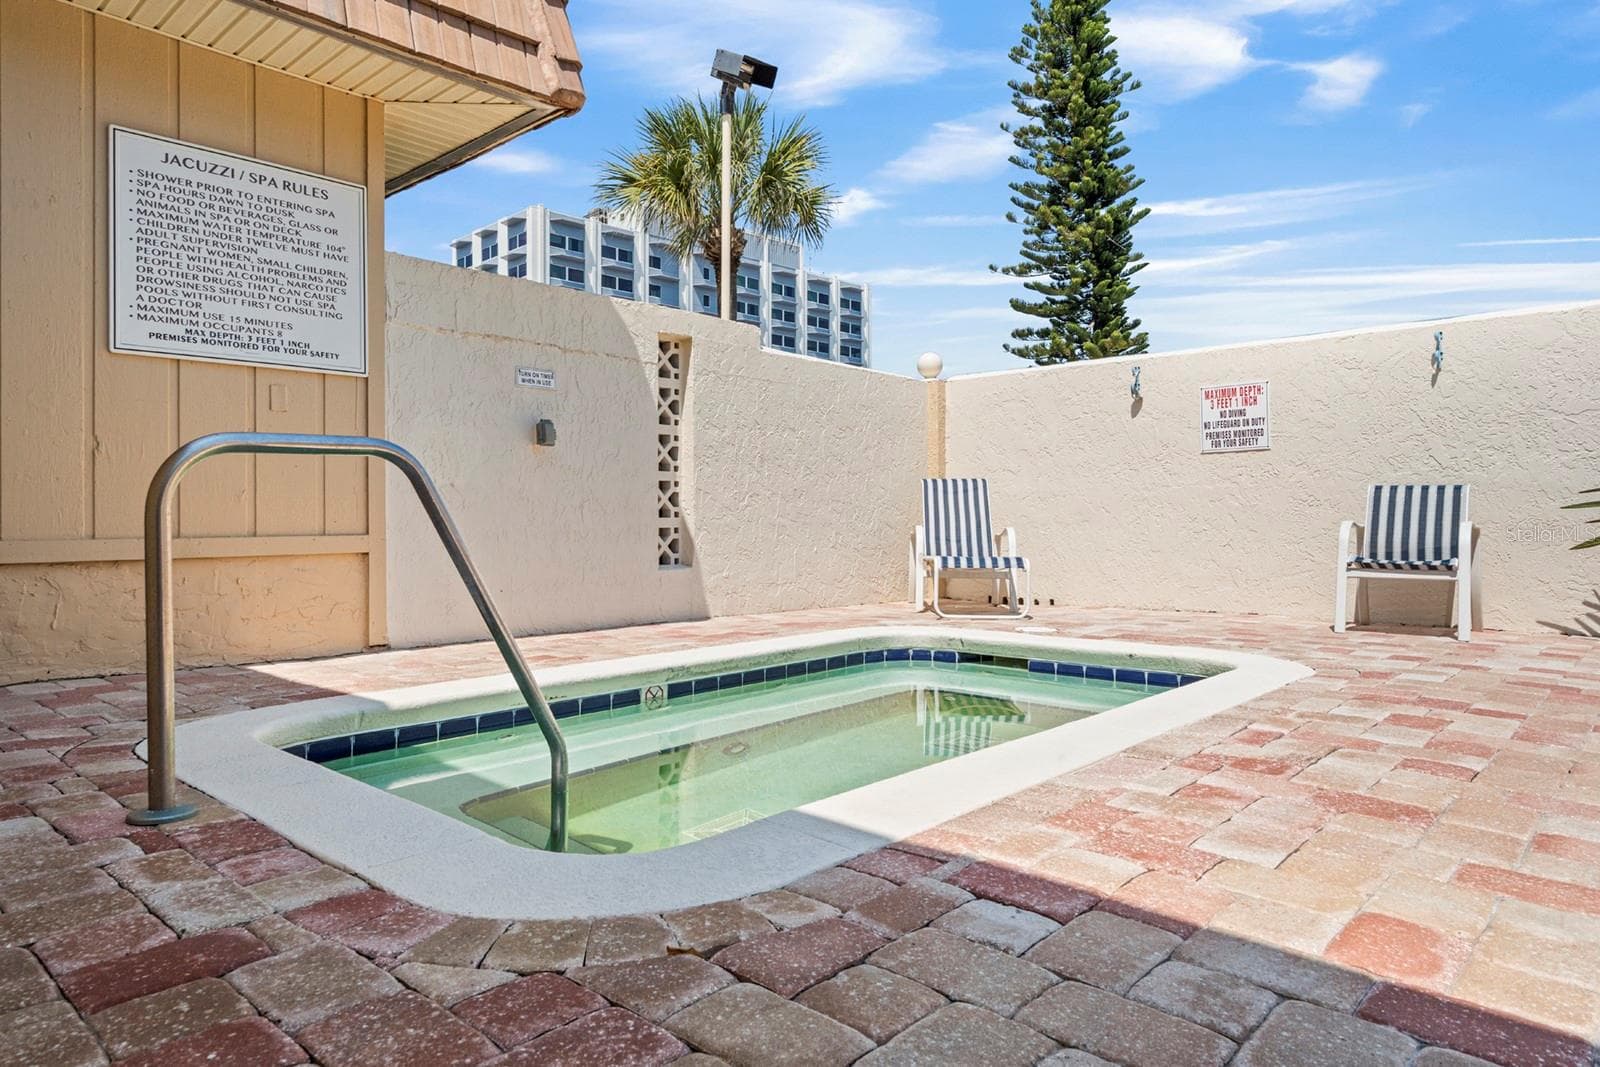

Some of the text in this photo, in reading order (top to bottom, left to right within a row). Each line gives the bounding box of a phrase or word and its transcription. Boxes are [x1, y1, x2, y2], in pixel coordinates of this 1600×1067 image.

[161, 153, 328, 200] JACUZZI / SPA RULES
[137, 169, 335, 218] SHOWER PRIOR TO ENTERING SPA
[137, 179, 295, 218] SPA HOURS DAWN TO DUSK
[136, 198, 191, 215] ANIMALS
[210, 213, 231, 223] SPA
[234, 218, 250, 227] OR
[253, 221, 269, 230] ON
[273, 225, 302, 237] DECK
[137, 189, 155, 198] NO
[160, 193, 195, 206] FOOD
[199, 202, 215, 210] OR
[289, 220, 321, 232] GLASS
[324, 227, 338, 236] OR
[137, 208, 199, 226] MAXIMUM
[202, 220, 242, 234] WATER
[247, 229, 321, 249] TEMPERATURE
[136, 228, 258, 254] ADULT SUPERVISION
[137, 218, 349, 263] CHILDREN UNDER TWELVE MUST HAVE
[137, 237, 202, 254] PREGNANT
[257, 257, 292, 270] SMALL
[136, 246, 183, 260] PEOPLE
[186, 254, 217, 266] WITH
[221, 260, 264, 274] HEALTH
[268, 269, 323, 284] PROBLEMS
[136, 256, 183, 269] PEOPLE
[187, 264, 223, 275] USING
[287, 280, 346, 295] NARCOTICS
[136, 265, 336, 302] OR OTHER DRUGS THAT CAN CAUSE
[136, 275, 336, 310] DROWSINESS SHOULD NOT USE SPA
[136, 285, 343, 320] POOLS WITHOUT FIRST CONSULTING
[137, 304, 199, 318] MAXIMUM
[203, 312, 225, 321] USE
[244, 318, 293, 330] MINUTES
[148, 295, 202, 309] DOCTOR
[137, 313, 199, 327] MAXIMUM
[203, 322, 274, 336] OCCUPANTS
[185, 328, 206, 336] MAX
[209, 331, 244, 341] DEPTH:
[256, 336, 276, 345] FEET
[288, 340, 310, 349] INCH
[149, 332, 339, 360] PREMISES MONITORED FOR YOUR SAFETY
[1205, 385, 1264, 400] MAXIMUM DEPTH:
[1210, 396, 1257, 410] 3 FEET 1 INCH
[1213, 419, 1240, 429] LIFEGUARD
[1252, 417, 1265, 426] DUTY
[1220, 409, 1246, 418] NO DIVING
[1206, 428, 1264, 440] PREMISES MONITORED
[1211, 438, 1258, 448] FOR YOUR SAFETY
